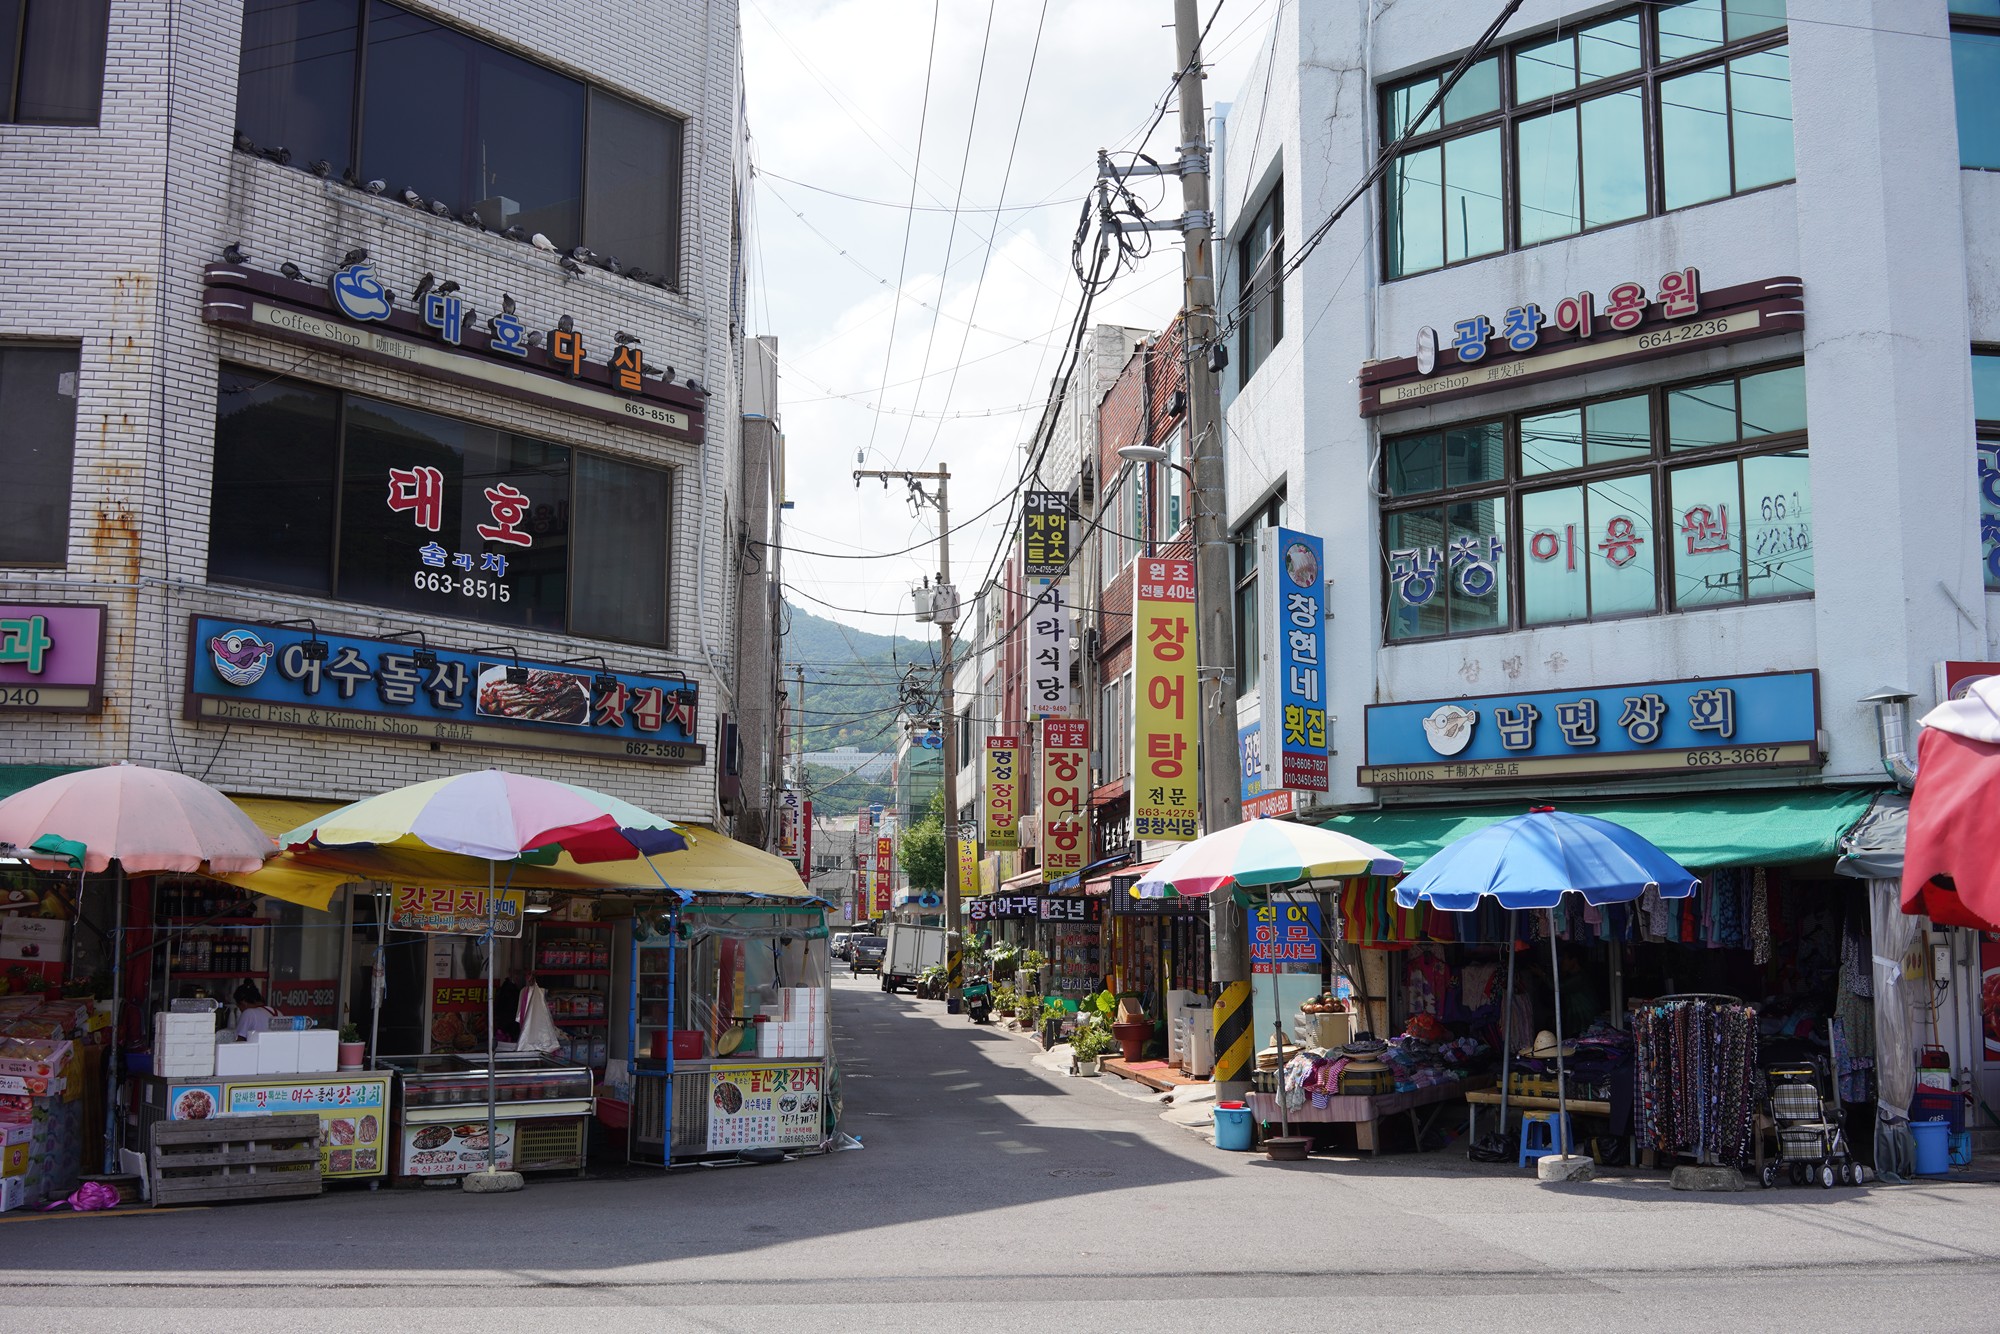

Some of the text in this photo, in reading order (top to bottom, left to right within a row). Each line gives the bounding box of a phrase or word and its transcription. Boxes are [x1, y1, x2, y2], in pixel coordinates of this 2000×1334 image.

[270, 309, 361, 347] Coffee Shop
[1638, 318, 1728, 350] 664-2236
[376, 337, 416, 359] 咖啡厅
[1487, 362, 1525, 381] 理发店
[1396, 373, 1469, 400] Barbershop
[625, 402, 676, 425] 663-8515
[1028, 493, 1067, 513] 아락
[1149, 563, 1189, 581] 원조
[414, 571, 511, 602] 663-8515
[1036, 588, 1065, 701] 아라식당
[1287, 593, 1319, 703] 창현네
[1147, 617, 1189, 778] 장어탕
[215, 700, 418, 736] Dried Fish & Kimchi Shop
[1047, 723, 1067, 732] 40년
[1284, 704, 1327, 748] 횟집
[1495, 687, 1733, 751] 남면상회
[434, 722, 474, 740] 食品店
[1049, 733, 1083, 747] 원조
[626, 741, 685, 760] 662-5580
[1686, 747, 1780, 767] 663-3667
[1371, 767, 1434, 783] Fashions
[1047, 752, 1083, 851] 장어탕
[1148, 787, 1187, 806] 전문
[1138, 808, 1194, 818] 663-4275
[1136, 818, 1196, 836] 명창식당
[1047, 853, 1081, 868] 전문
[400, 887, 484, 916] 갓김치
[458, 916, 515, 932] 662-580
[1250, 943, 1316, 959] 샤브샤브
